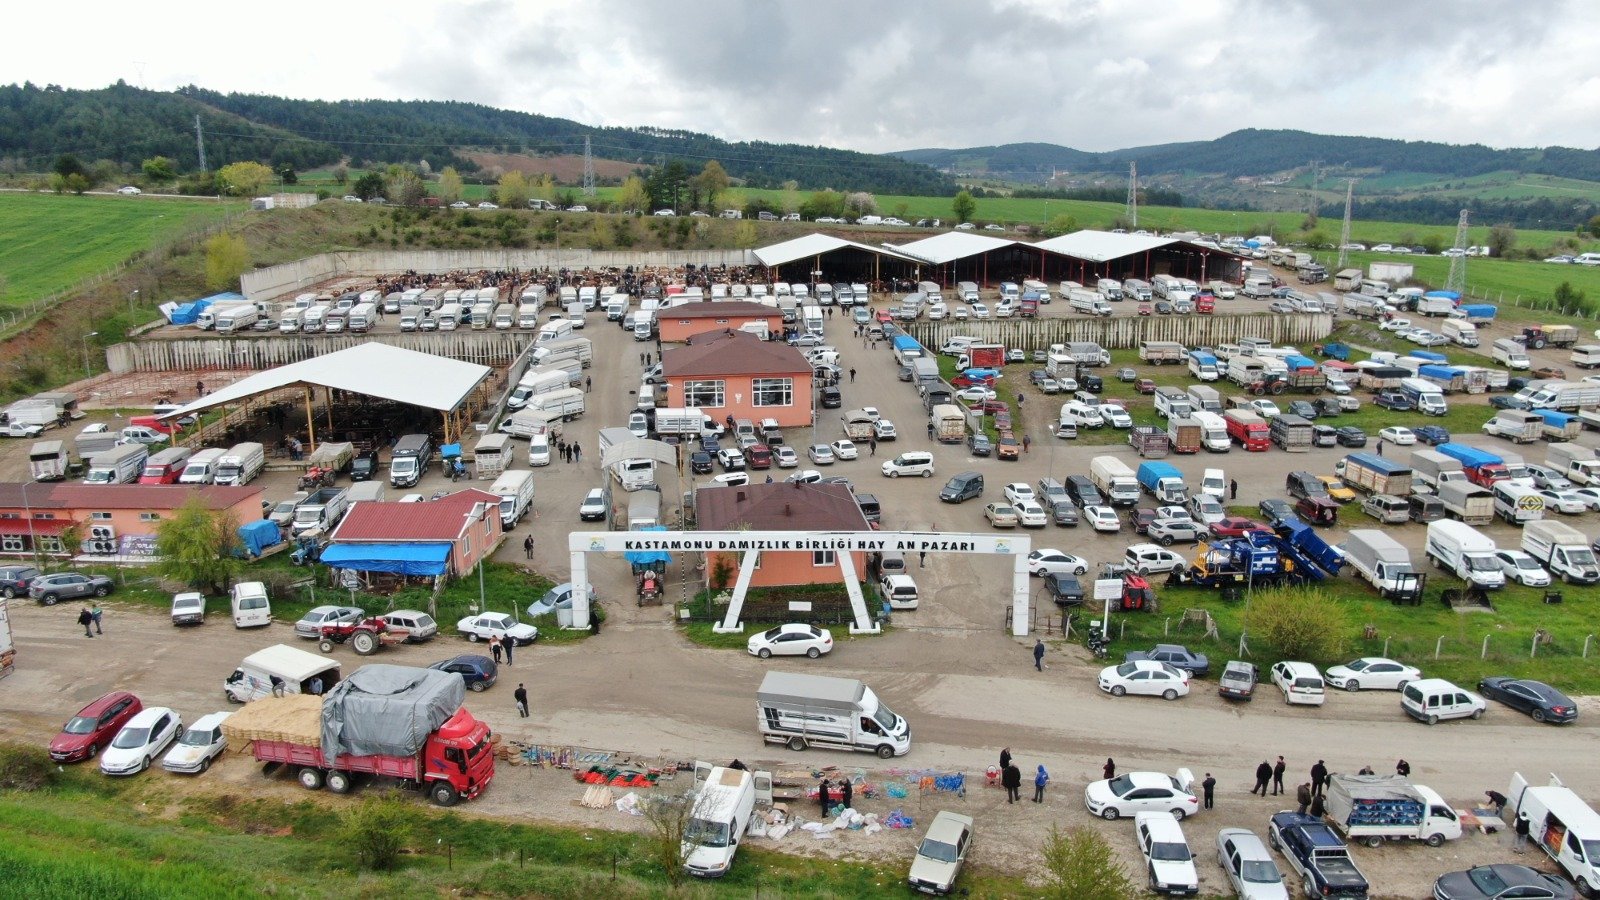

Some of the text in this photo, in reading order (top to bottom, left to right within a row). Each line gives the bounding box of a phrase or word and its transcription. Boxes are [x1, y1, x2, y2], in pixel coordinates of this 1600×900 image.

[625, 540, 713, 549] KASTAMONU
[718, 540, 790, 549] DAMIZLIK
[796, 538, 852, 549] BİRLİĞİ
[922, 542, 975, 550] PAZARI
